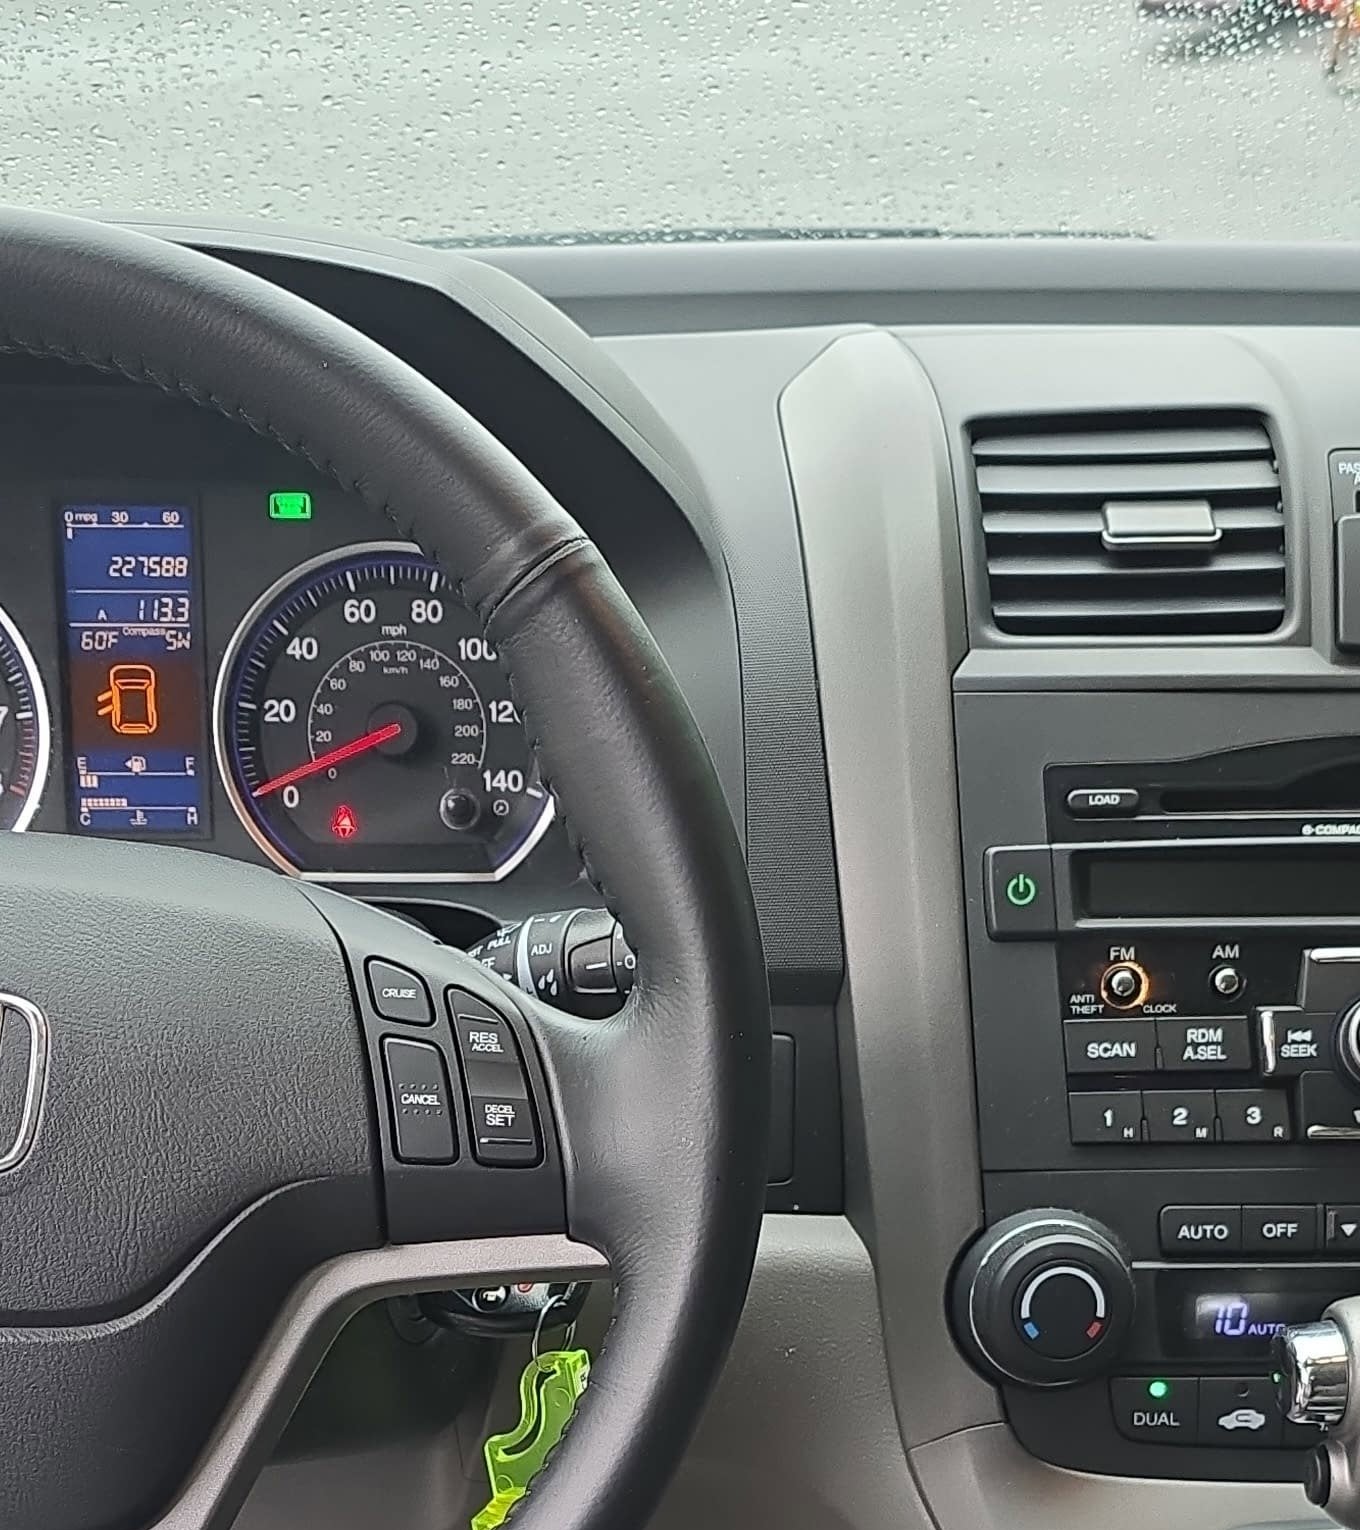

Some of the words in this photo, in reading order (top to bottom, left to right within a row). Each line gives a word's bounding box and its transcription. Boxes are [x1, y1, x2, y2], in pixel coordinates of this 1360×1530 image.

[64, 511, 74, 522] 0
[75, 512, 98, 524] mpg
[111, 511, 129, 523] 30
[162, 511, 180, 523] 60
[109, 556, 188, 577] 227588
[98, 609, 108, 621] A
[344, 599, 376, 623] 60
[411, 599, 443, 623] 80
[381, 624, 407, 637] mph
[122, 627, 165, 638] Compass
[165, 630, 191, 651] SW
[286, 637, 318, 661] 40
[369, 651, 390, 662] 100
[396, 650, 417, 662] 120
[348, 660, 365, 673] 80
[383, 666, 408, 675] km/h
[419, 658, 440, 671] 140
[330, 678, 347, 691] 60
[439, 675, 460, 688] 160
[316, 703, 333, 716] 40
[452, 698, 473, 710] 180
[263, 699, 296, 723] 20
[315, 731, 332, 743] 20
[454, 725, 479, 737] 200
[451, 753, 476, 765] 220
[327, 768, 338, 780] 0
[483, 769, 523, 793] 140
[283, 786, 299, 808] 0
[1089, 794, 1120, 805] LOAD
[530, 943, 553, 957] ADJ
[1110, 947, 1135, 961] FM
[1212, 945, 1240, 959] AM
[382, 988, 417, 999] CRUISE
[1070, 995, 1095, 1004] ANTI
[1070, 1004, 1104, 1014] THEFT
[1143, 1004, 1177, 1014] CLOCK
[469, 1031, 498, 1044] RES
[1187, 1028, 1223, 1042] RDM
[471, 1043, 504, 1053] ACCEL
[1087, 1042, 1137, 1058] SCAN
[1183, 1046, 1228, 1060] A.SEL
[1281, 1044, 1317, 1058] SEEK
[401, 1094, 441, 1106] CANCEL
[484, 1104, 516, 1115] DECEL
[1246, 1106, 1262, 1125] 3
[485, 1114, 516, 1127] SET
[1103, 1108, 1113, 1128] 1
[1172, 1107, 1189, 1126] 2
[1123, 1127, 1134, 1138] H
[1195, 1127, 1207, 1138] M
[1273, 1127, 1284, 1138] R
[1177, 1225, 1229, 1240] AUTO
[1262, 1223, 1299, 1238] OFF
[1133, 1412, 1180, 1427] DUAL
